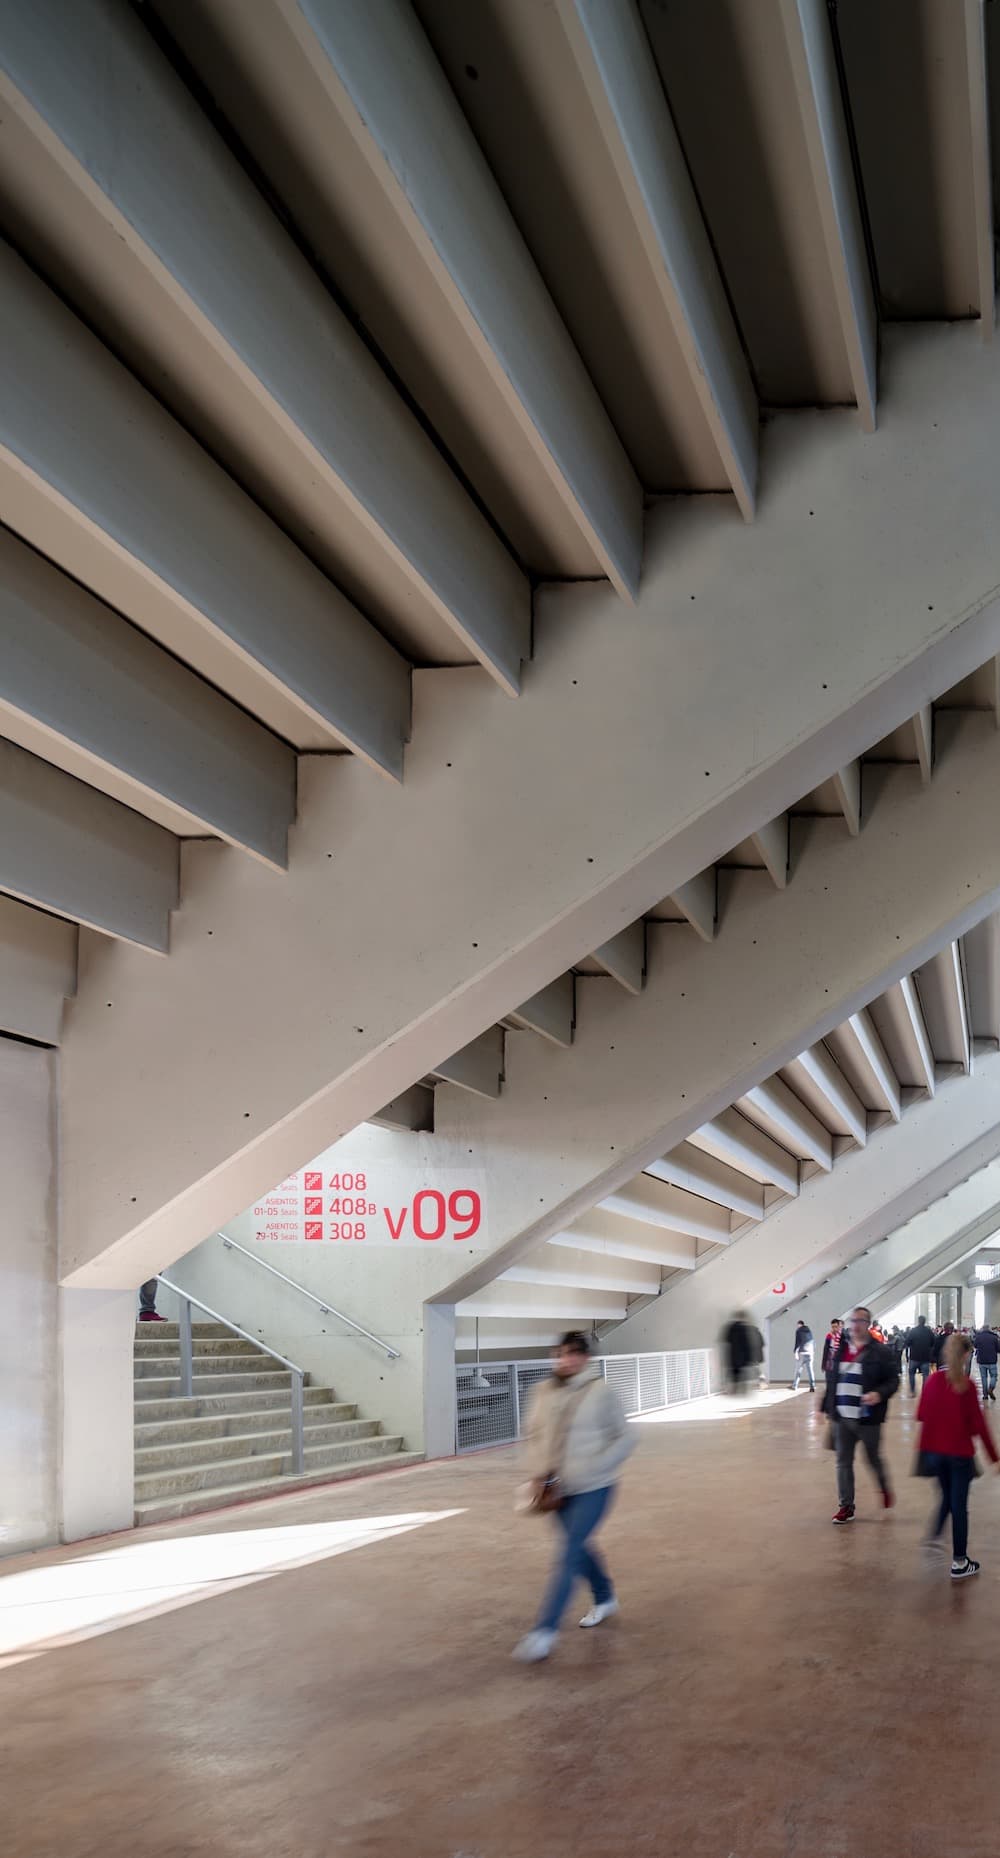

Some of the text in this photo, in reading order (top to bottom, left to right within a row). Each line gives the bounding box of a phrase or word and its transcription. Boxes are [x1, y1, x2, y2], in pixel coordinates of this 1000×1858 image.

[328, 1173, 367, 1192] 408
[265, 1198, 298, 1206] ASIENTOS
[254, 1207, 278, 1216] 01-05
[265, 1222, 299, 1231] ASIENTOS
[255, 1231, 279, 1241] 29-15
[328, 1222, 367, 1241] 308
